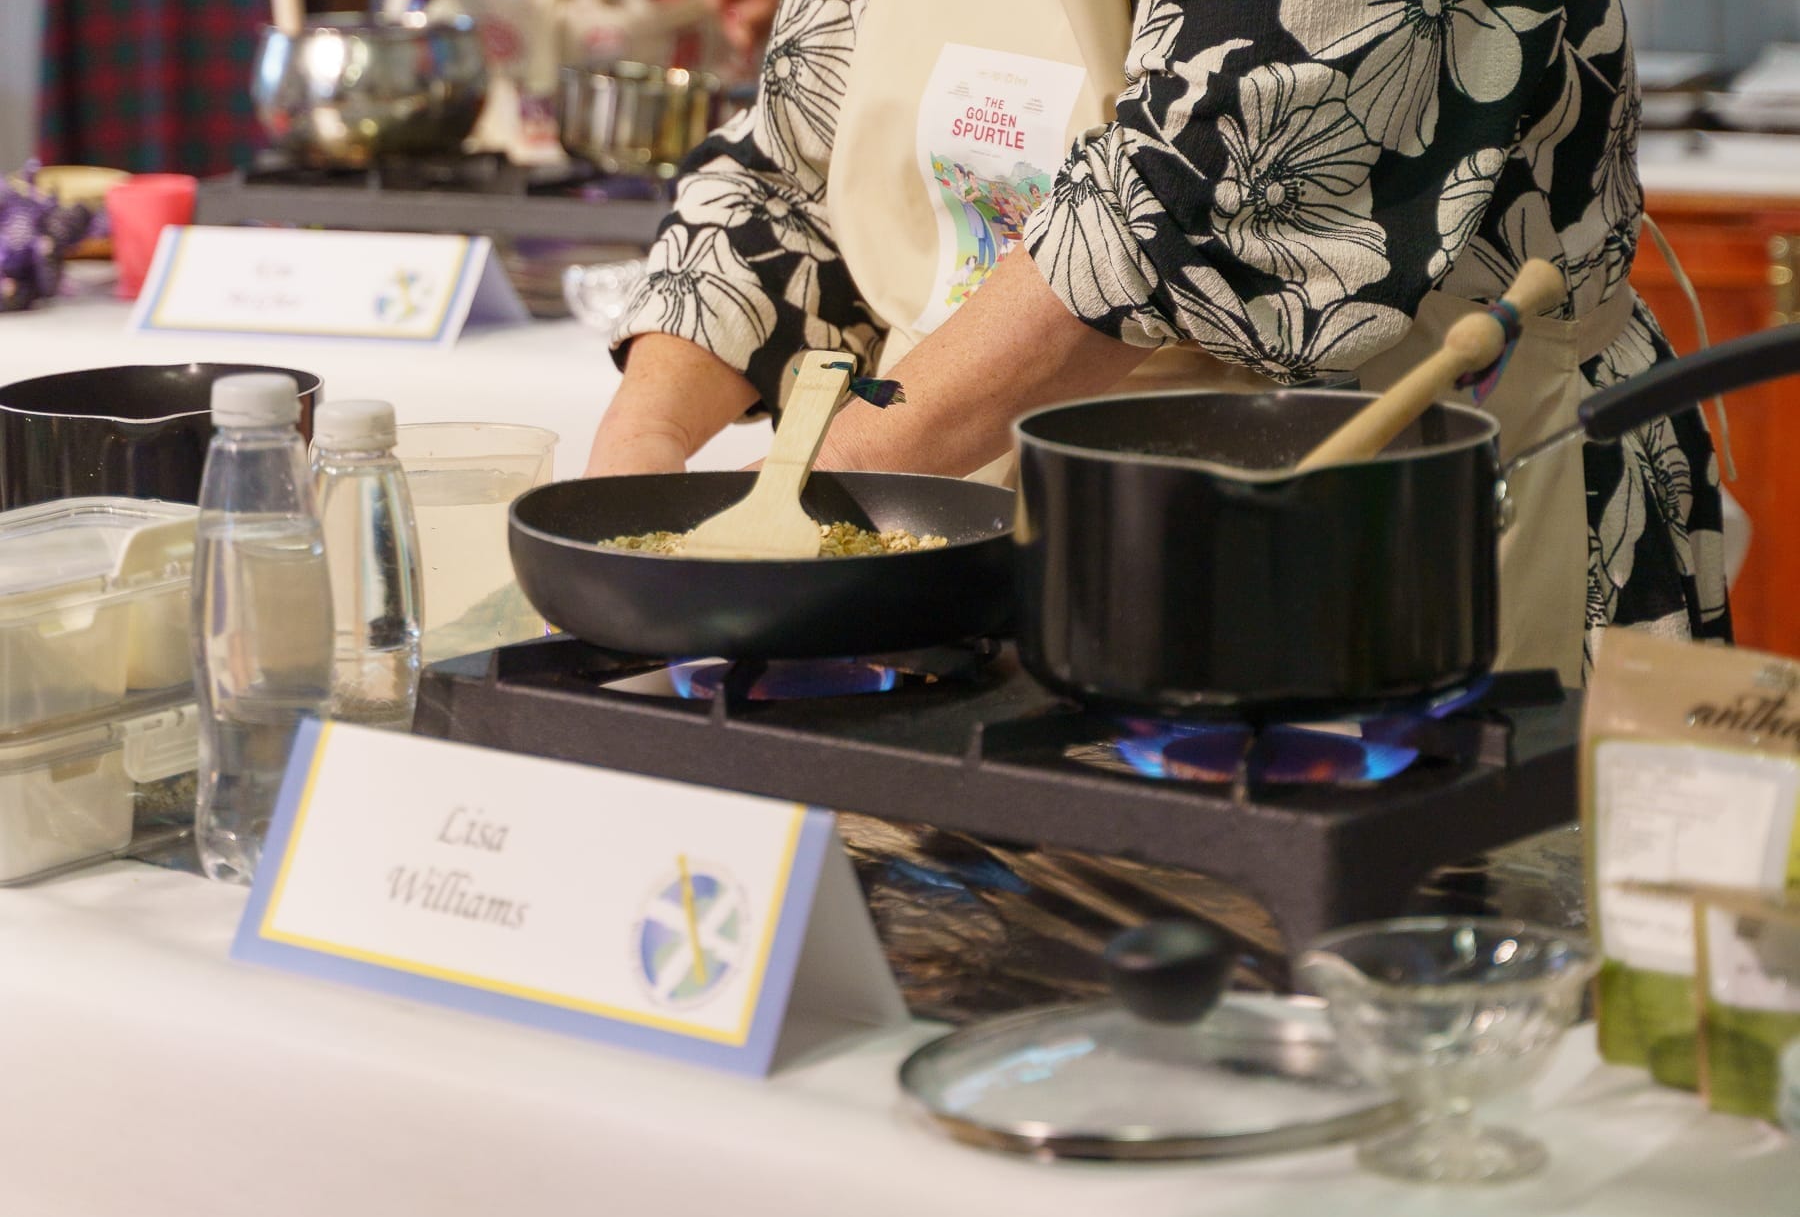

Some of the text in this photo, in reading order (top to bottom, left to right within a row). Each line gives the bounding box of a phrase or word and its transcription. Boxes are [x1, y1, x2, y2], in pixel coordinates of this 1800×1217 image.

[966, 106, 1017, 128] GOLDEN
[984, 96, 1005, 110] THE
[952, 118, 1025, 150] SPURTLE
[436, 804, 510, 853] Lisa
[386, 863, 532, 930] Williams
